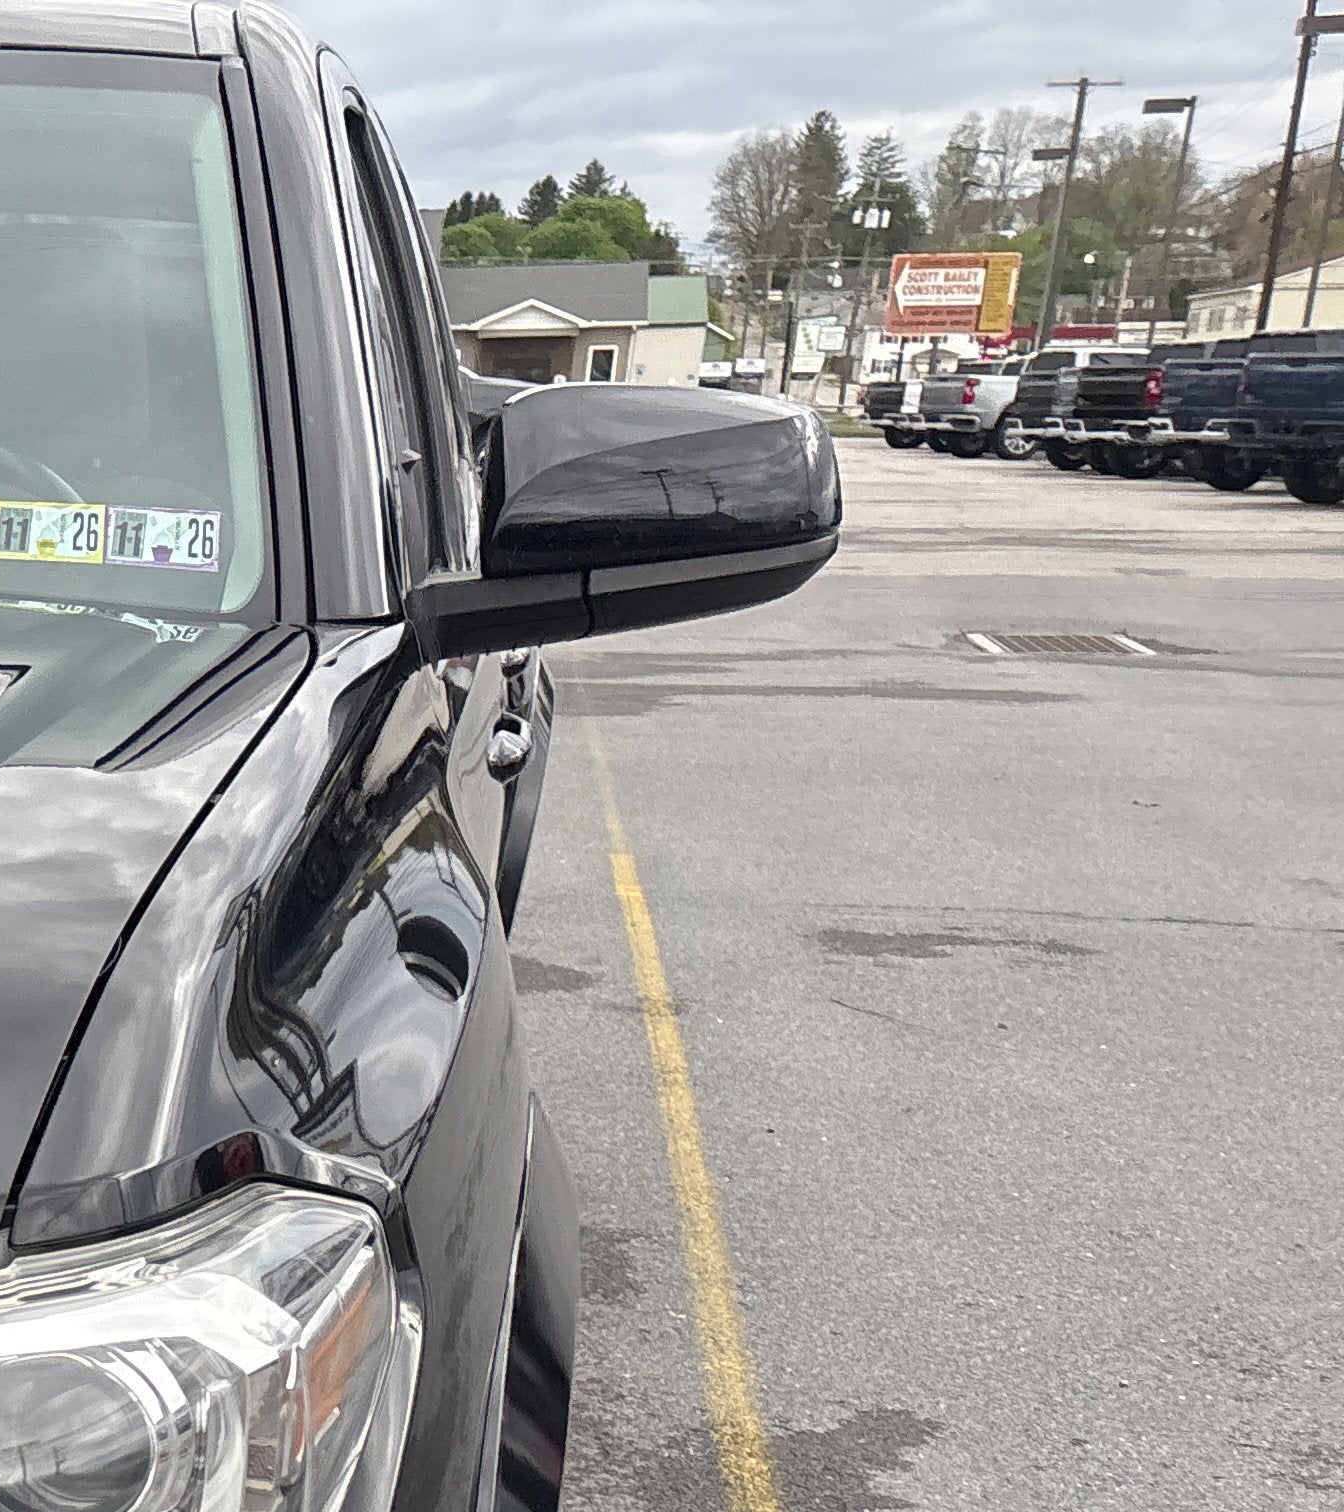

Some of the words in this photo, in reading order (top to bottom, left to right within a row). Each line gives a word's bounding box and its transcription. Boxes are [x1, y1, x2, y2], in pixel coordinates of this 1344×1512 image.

[907, 271, 940, 283] SCOTT
[901, 284, 981, 297] CONSTRUCTION
[1, 517, 29, 551] 11
[72, 512, 99, 551] 26
[115, 521, 143, 557] 11
[187, 518, 214, 559] 26
